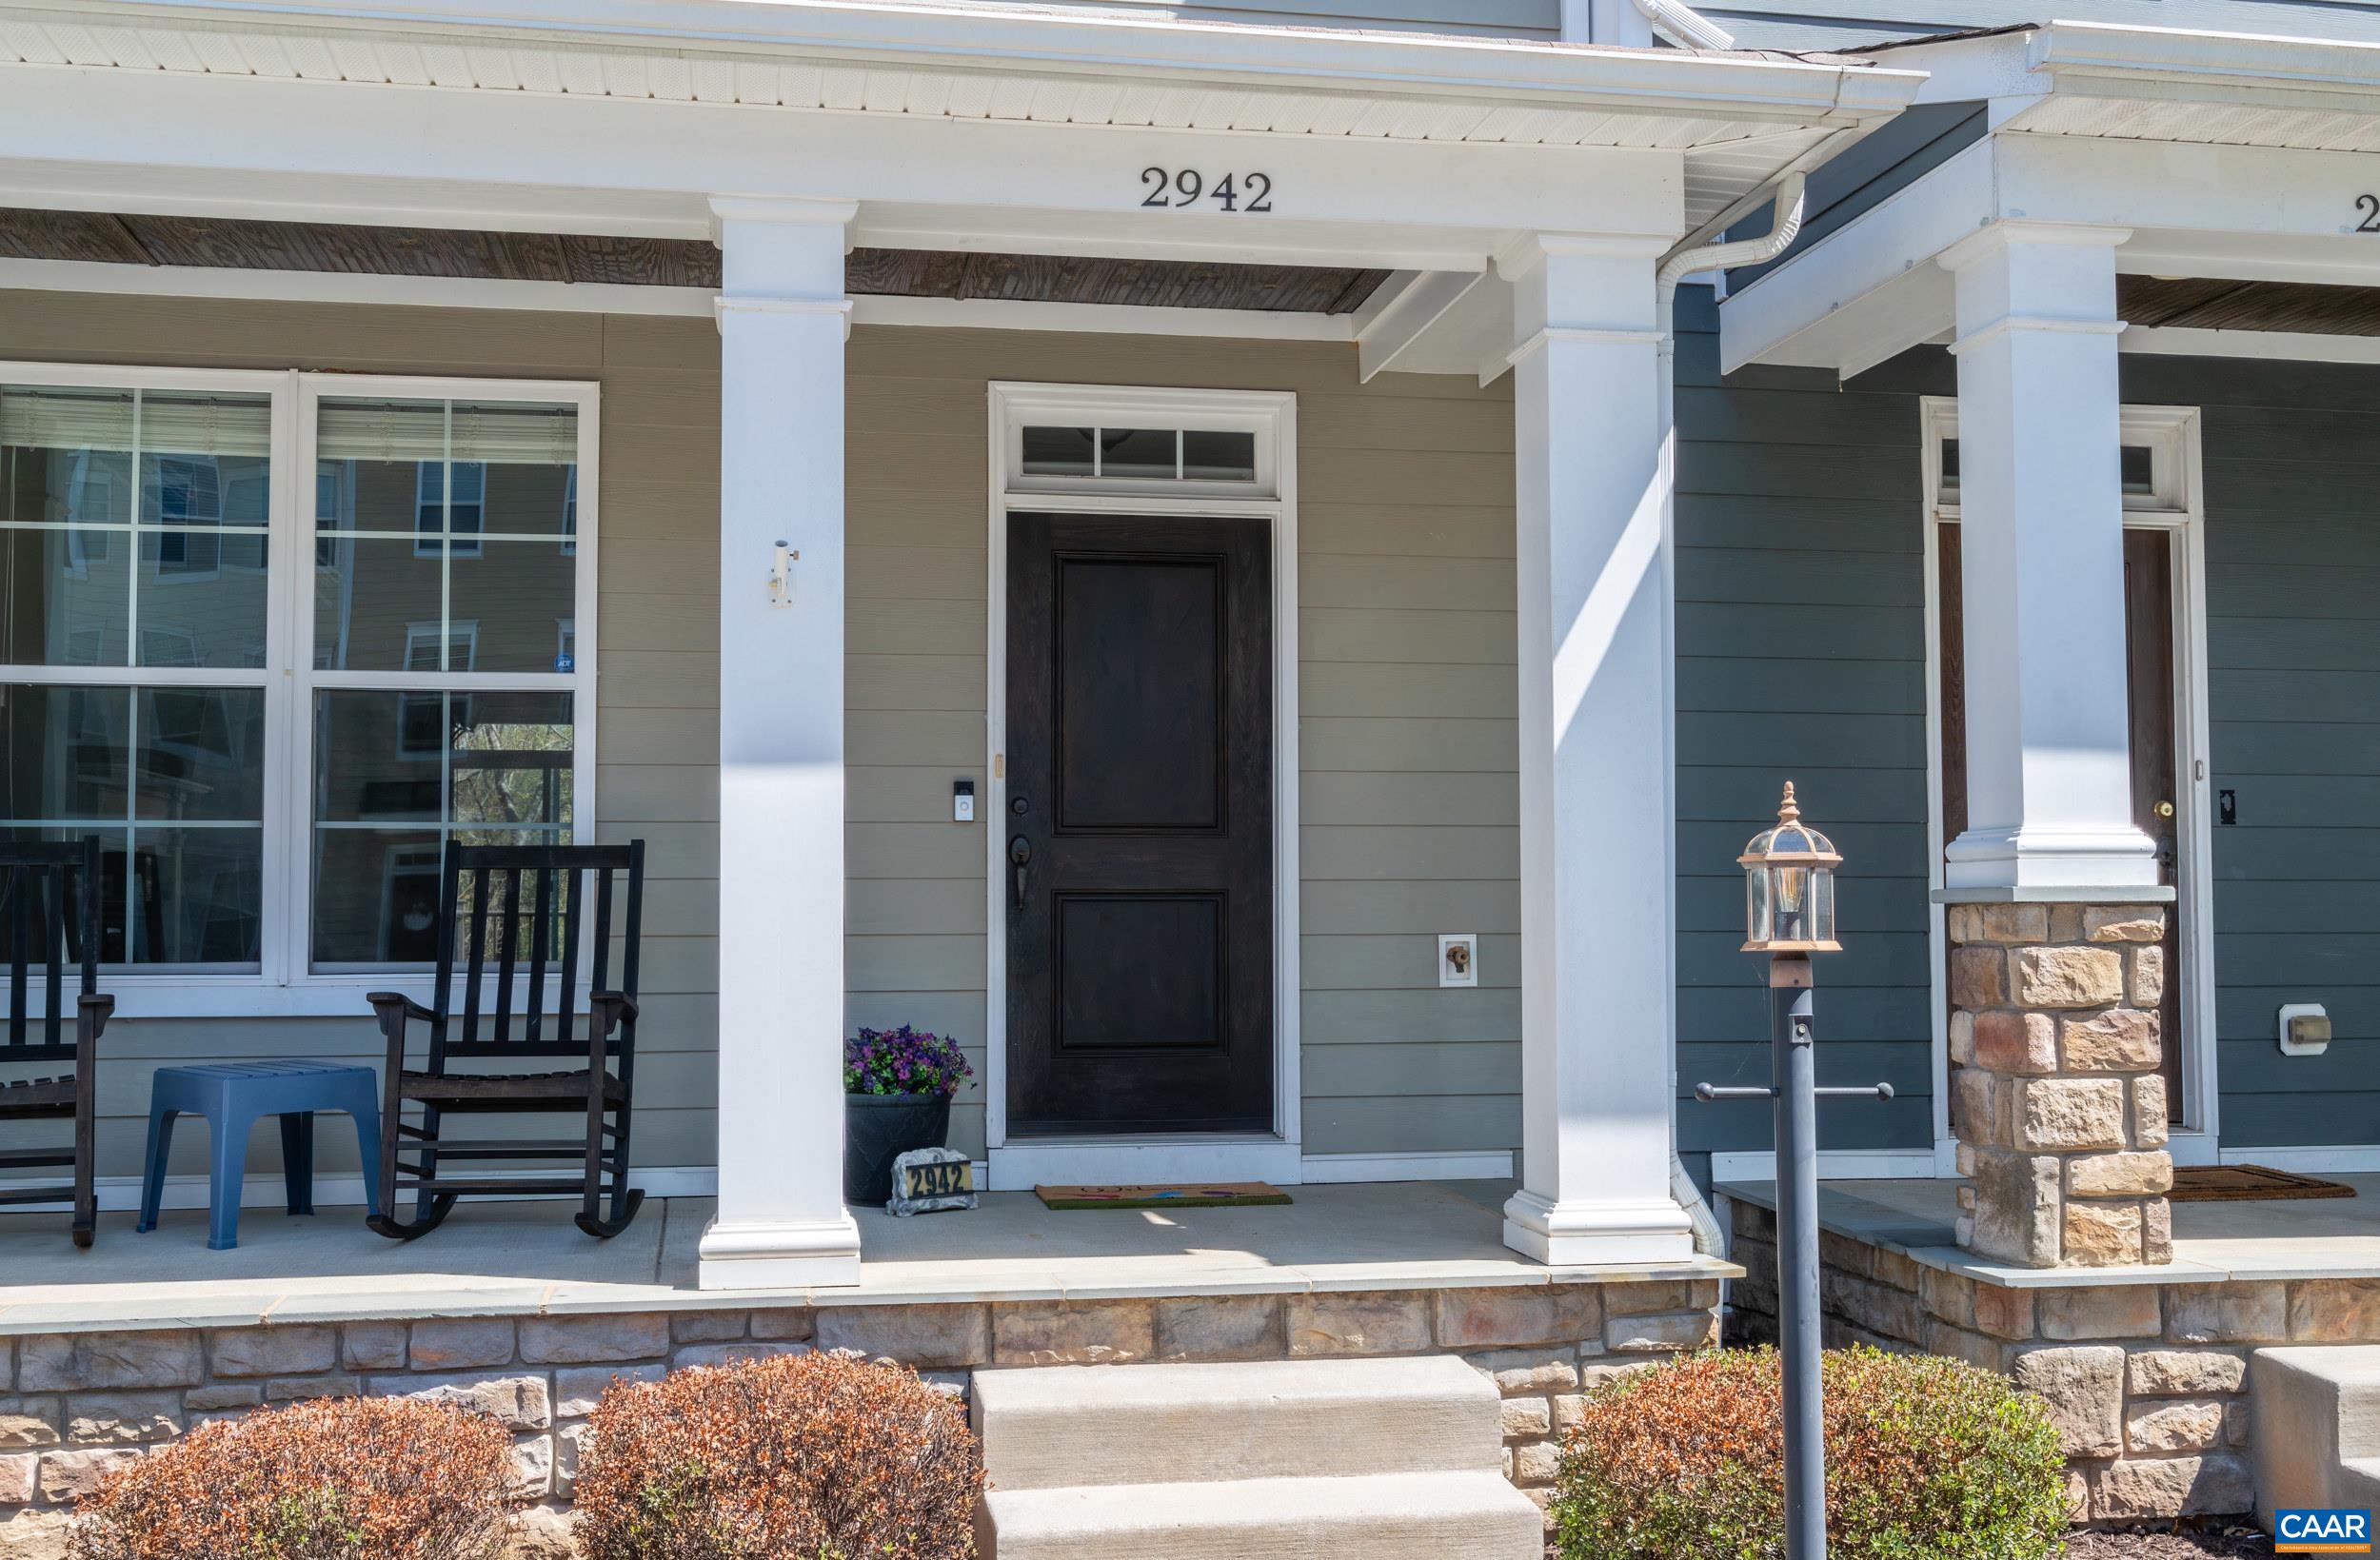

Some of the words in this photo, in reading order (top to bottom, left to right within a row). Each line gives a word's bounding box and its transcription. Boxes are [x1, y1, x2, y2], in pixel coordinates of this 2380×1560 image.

[1140, 167, 1272, 212] 2942
[2355, 194, 2380, 232] 2
[911, 1163, 964, 1197] 2942
